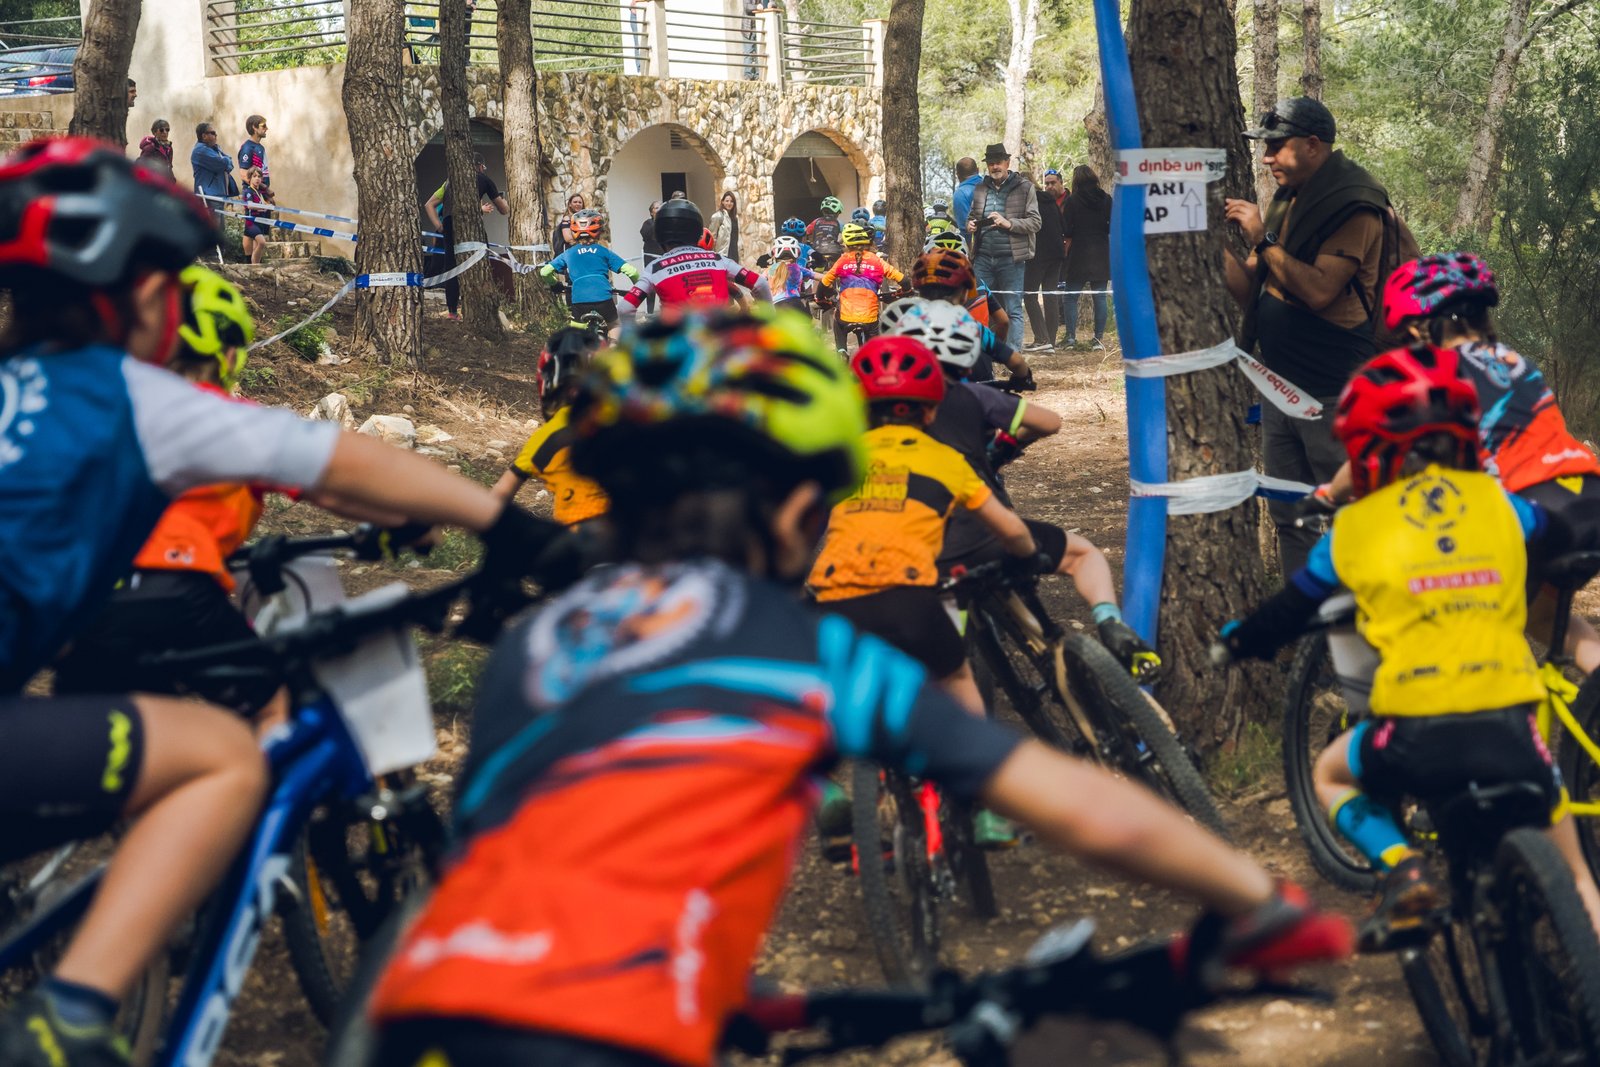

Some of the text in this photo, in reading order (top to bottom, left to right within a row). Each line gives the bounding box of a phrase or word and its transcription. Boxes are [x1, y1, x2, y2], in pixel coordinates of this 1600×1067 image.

[577, 247, 598, 255] IBAI
[660, 252, 716, 267] BAUHAUS
[666, 261, 717, 275] 2009-2024
[1266, 373, 1301, 405] equip
